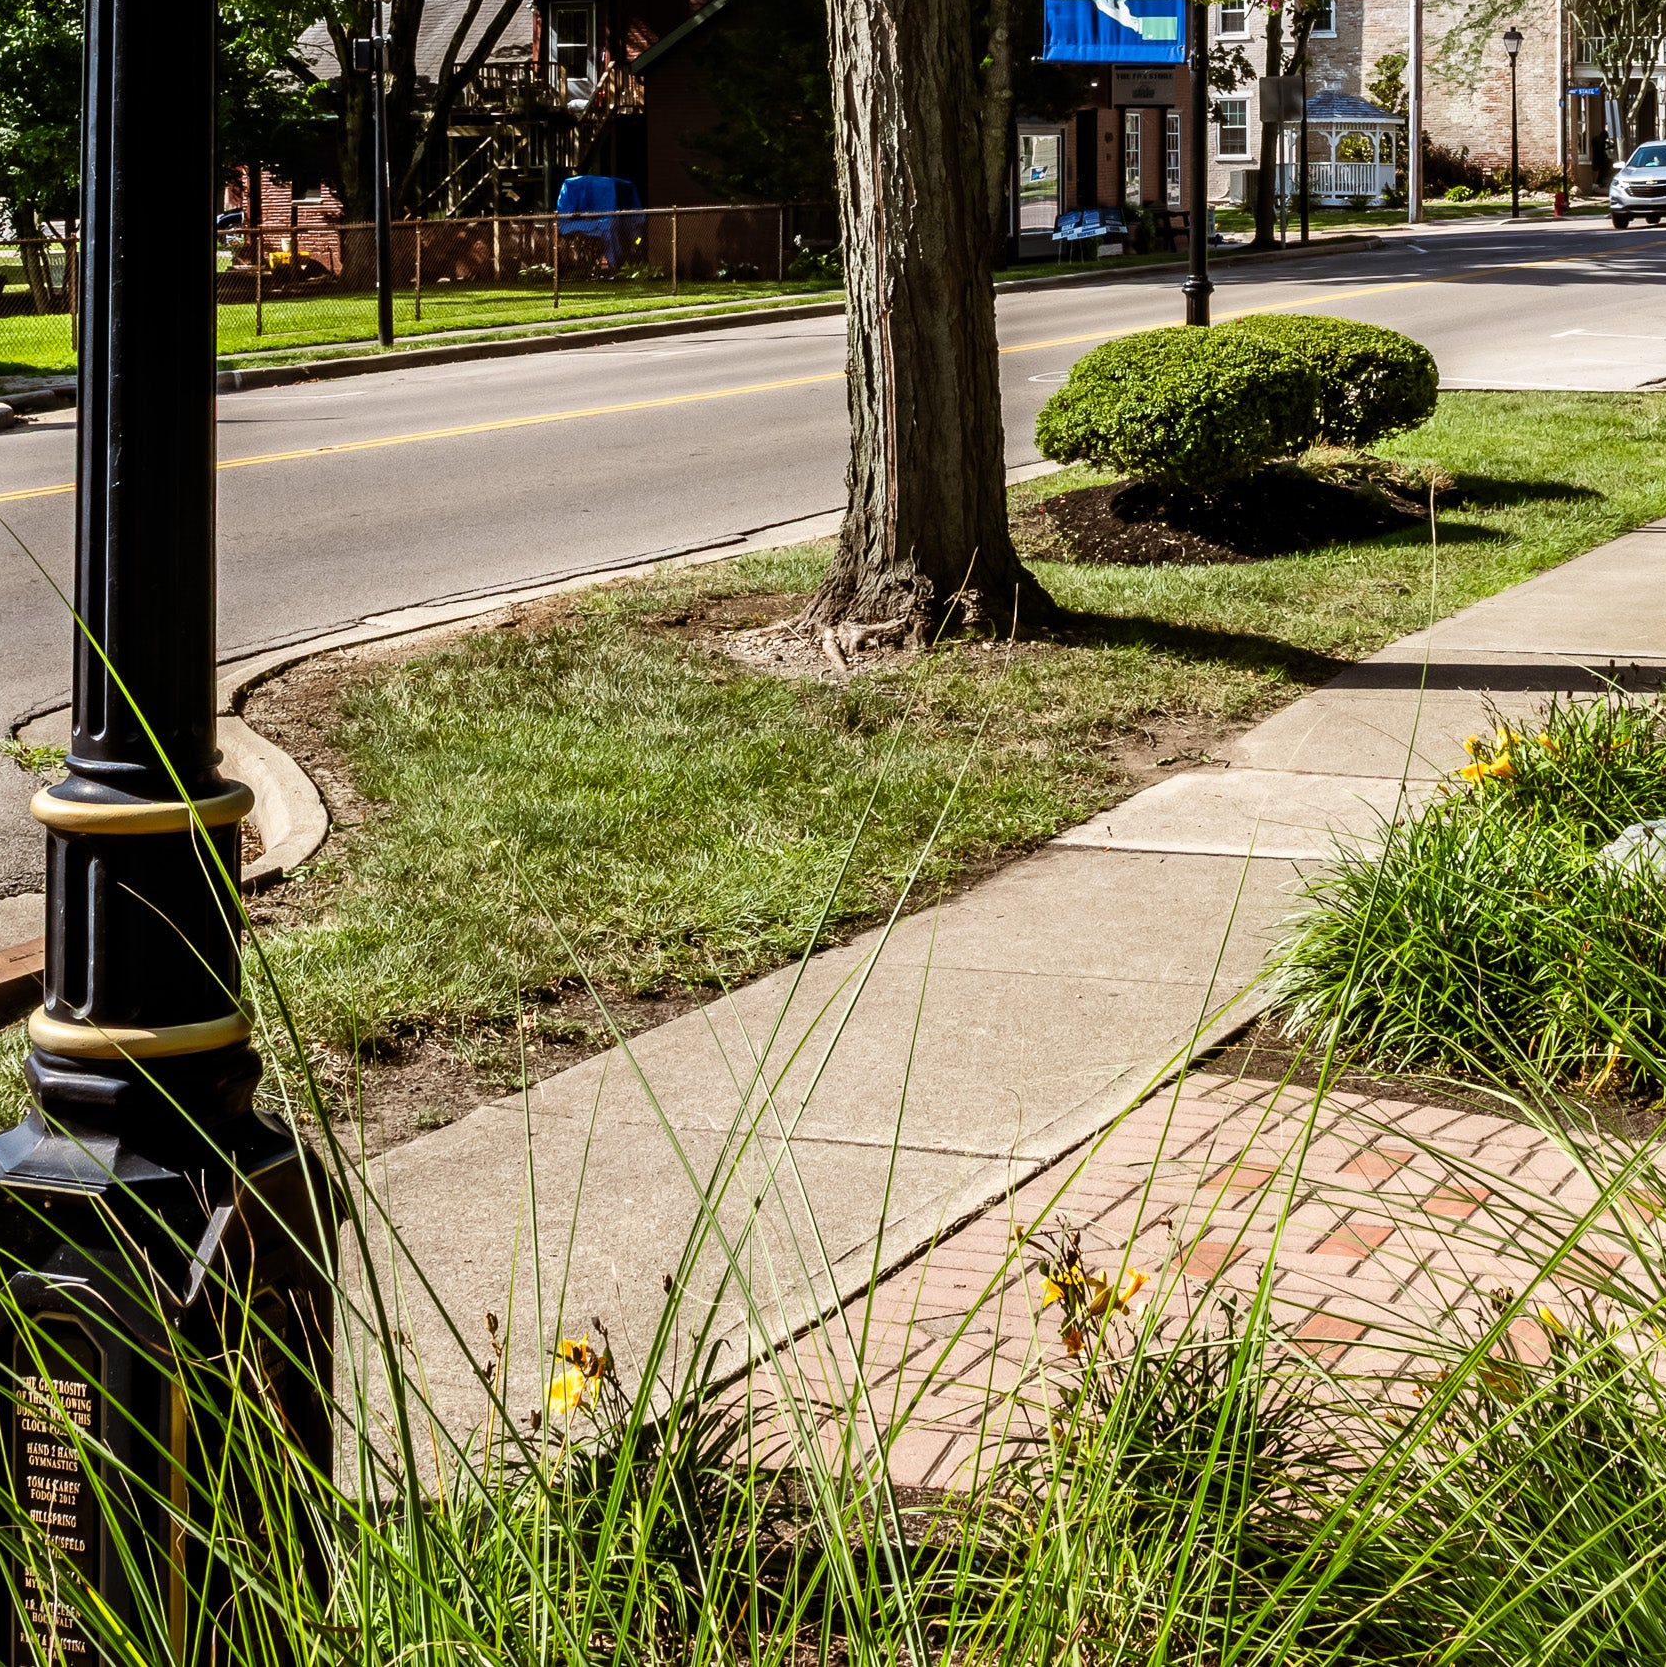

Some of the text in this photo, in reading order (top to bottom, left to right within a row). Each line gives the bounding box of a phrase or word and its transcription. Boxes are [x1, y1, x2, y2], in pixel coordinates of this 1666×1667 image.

[26, 1442, 50, 1456] HAND
[28, 1455, 78, 1472] GYMNASTICS
[26, 1476, 45, 1490] TOM
[52, 1479, 81, 1494] KAREN
[30, 1488, 76, 1505] FODOR 2012
[29, 1509, 77, 1528] HILLSPRING
